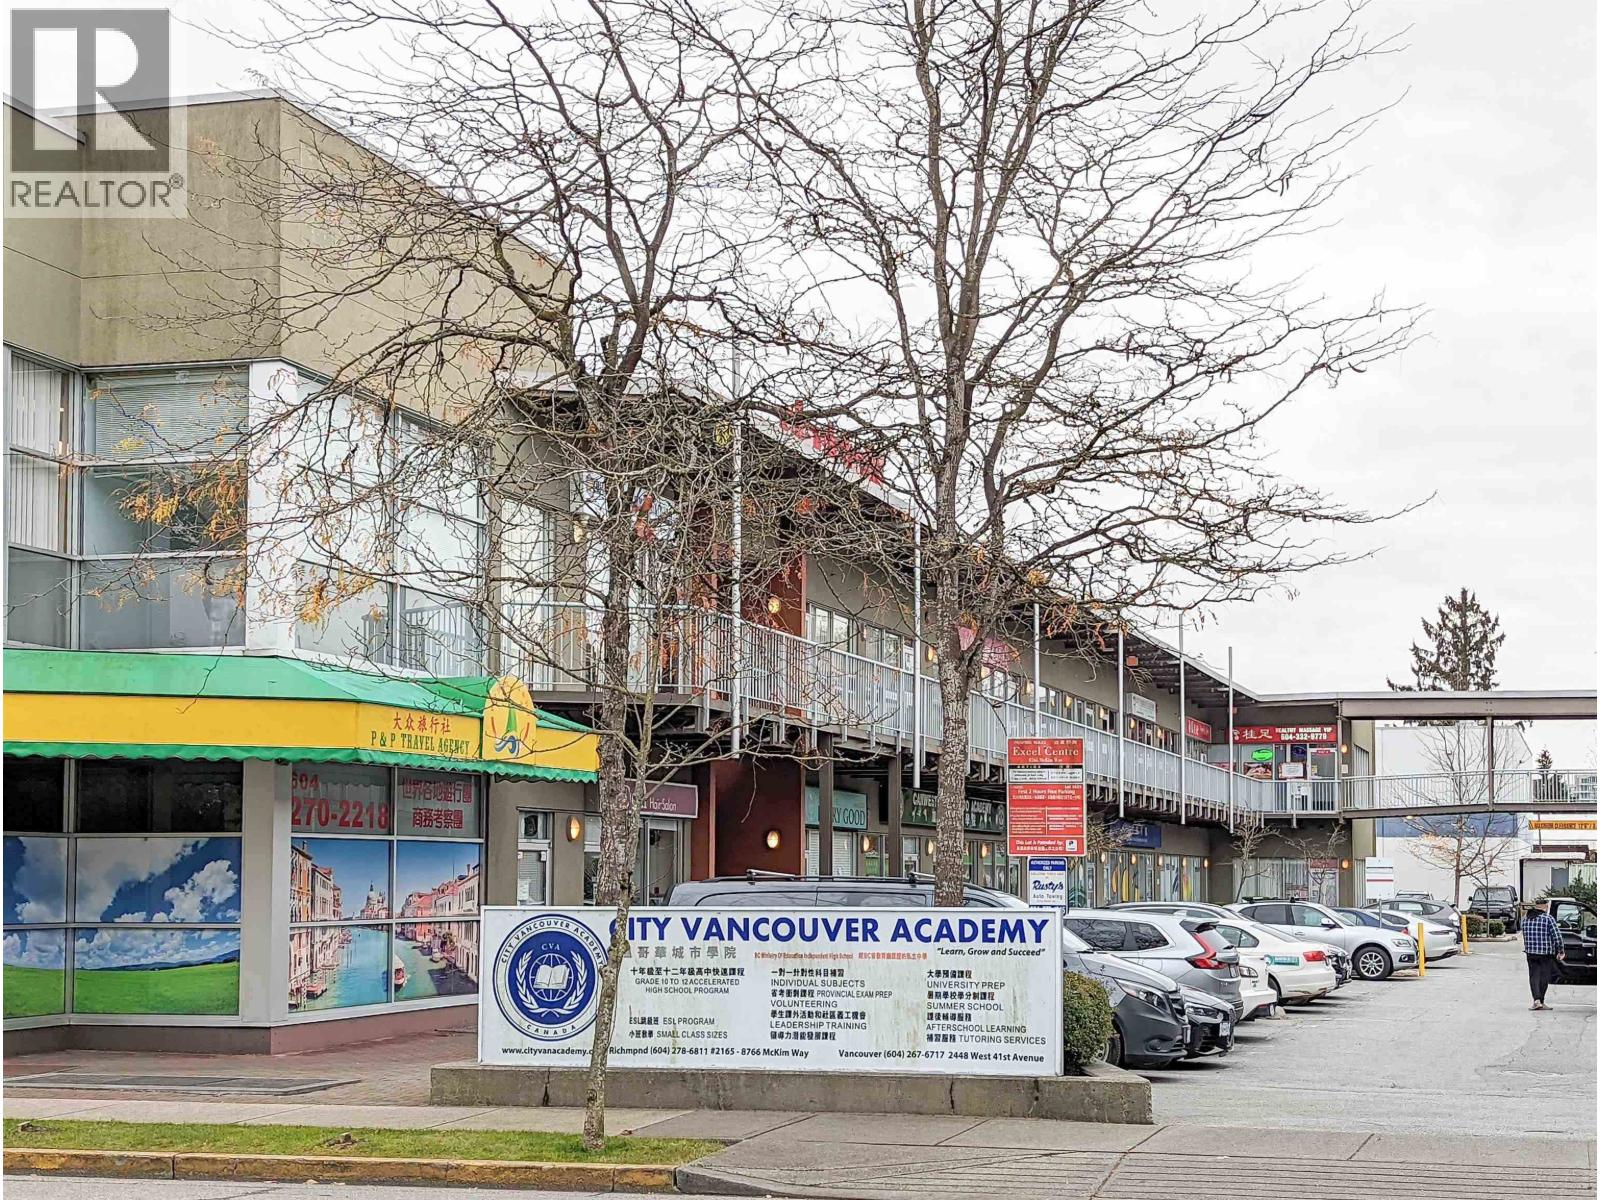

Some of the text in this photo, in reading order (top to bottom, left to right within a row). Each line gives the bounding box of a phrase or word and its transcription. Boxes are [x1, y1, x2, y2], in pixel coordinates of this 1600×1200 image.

[371, 731, 470, 755] P & P TRAVEL AGENCY
[1013, 746, 1079, 756] Excel Centre
[291, 796, 389, 830] 270-2218
[843, 808, 865, 825] GOOD
[1032, 880, 1064, 893] Rusty's
[682, 917, 880, 943] VANCOUVER
[891, 918, 1049, 944] ACADEMY
[501, 942, 517, 964] CITY
[514, 920, 570, 941] VANCOUVER
[541, 943, 560, 951] CVA
[967, 948, 990, 956] Grow
[991, 948, 1007, 956] and
[689, 978, 740, 986] ACCELERATED
[771, 979, 866, 988] INDIVIDUAL SUBJECTS
[927, 981, 1006, 990] UNIVERSITY PREP
[817, 990, 856, 998] PROVINCIAL
[875, 991, 892, 999] PREP
[771, 1000, 838, 1008] VOLUNTEERING
[927, 1002, 1004, 1011] SUMMER SCHOOL
[663, 1017, 715, 1025] ESL PROGRAM
[770, 1021, 867, 1030] LEADERSHIP TRAINING
[526, 1024, 576, 1036] CANADA
[926, 1023, 1027, 1034] AFTERSCHOOL LEARNING
[657, 1030, 728, 1039] SMALL CLASS SIZES
[959, 1034, 1047, 1045] TUTORING SERVICES
[650, 1046, 670, 1056] (604)
[671, 1046, 708, 1056] 278-6811
[710, 1047, 734, 1056] #2165
[741, 1048, 761, 1056] 8766
[762, 1048, 790, 1057] McKim
[791, 1049, 809, 1059] Way
[839, 1049, 945, 1059] Vancouver (604) 267-6717
[948, 1051, 1045, 1062] 2448 West 41st Avenue
